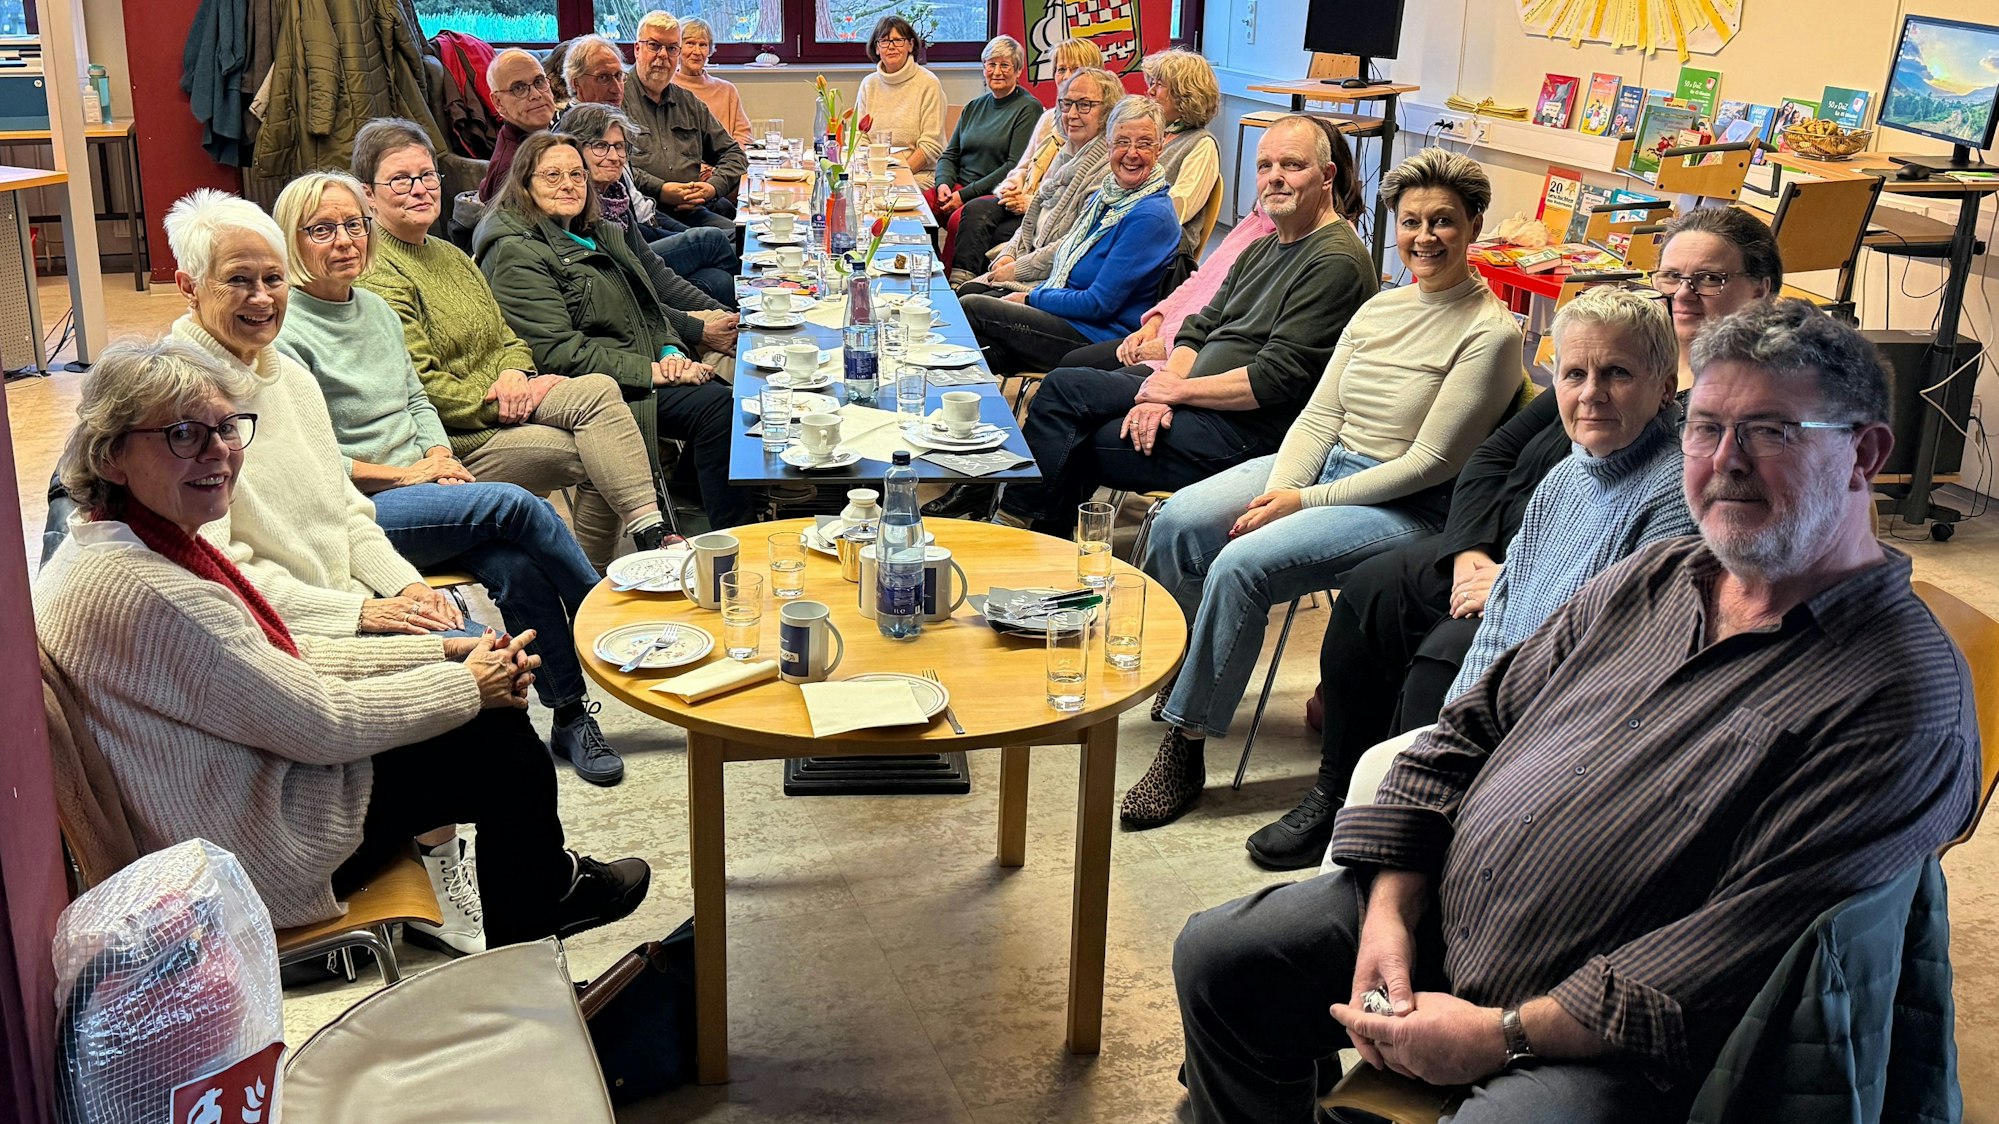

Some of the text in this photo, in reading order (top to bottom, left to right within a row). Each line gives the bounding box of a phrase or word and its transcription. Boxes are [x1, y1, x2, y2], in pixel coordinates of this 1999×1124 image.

[1838, 102, 1849, 110] DaZ
[1550, 181, 1563, 194] 20
[1548, 193, 1574, 203] Geschichten
